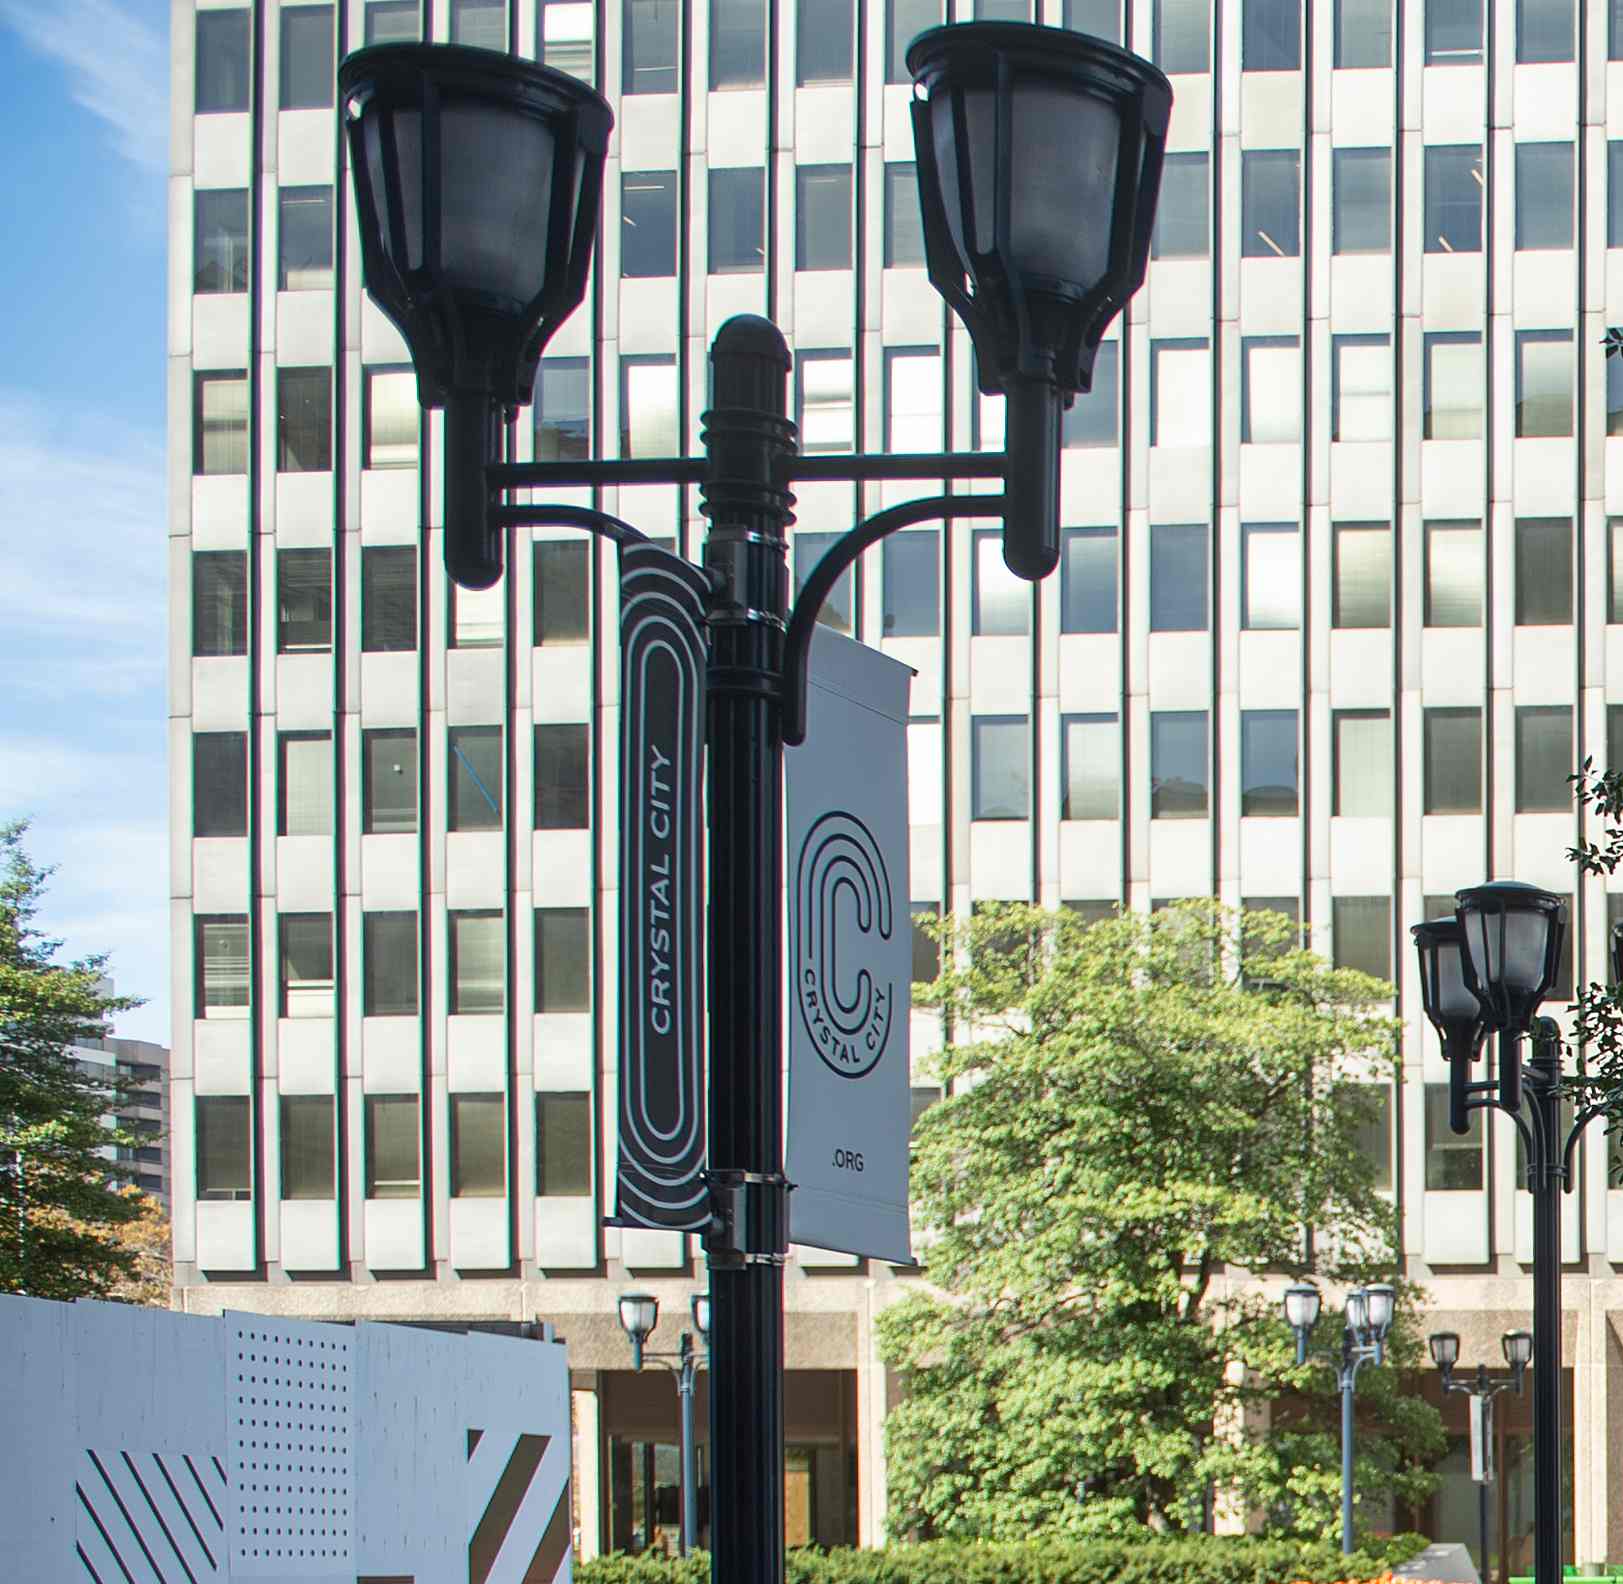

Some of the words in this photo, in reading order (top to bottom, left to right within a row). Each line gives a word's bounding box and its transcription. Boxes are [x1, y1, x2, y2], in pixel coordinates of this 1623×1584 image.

[650, 744, 671, 840] CITY
[650, 853, 671, 1035] CRYSTAL
[804, 968, 860, 1064] CRYSTAL
[866, 987, 885, 1051] CITY
[832, 1149, 864, 1172] .ORG
